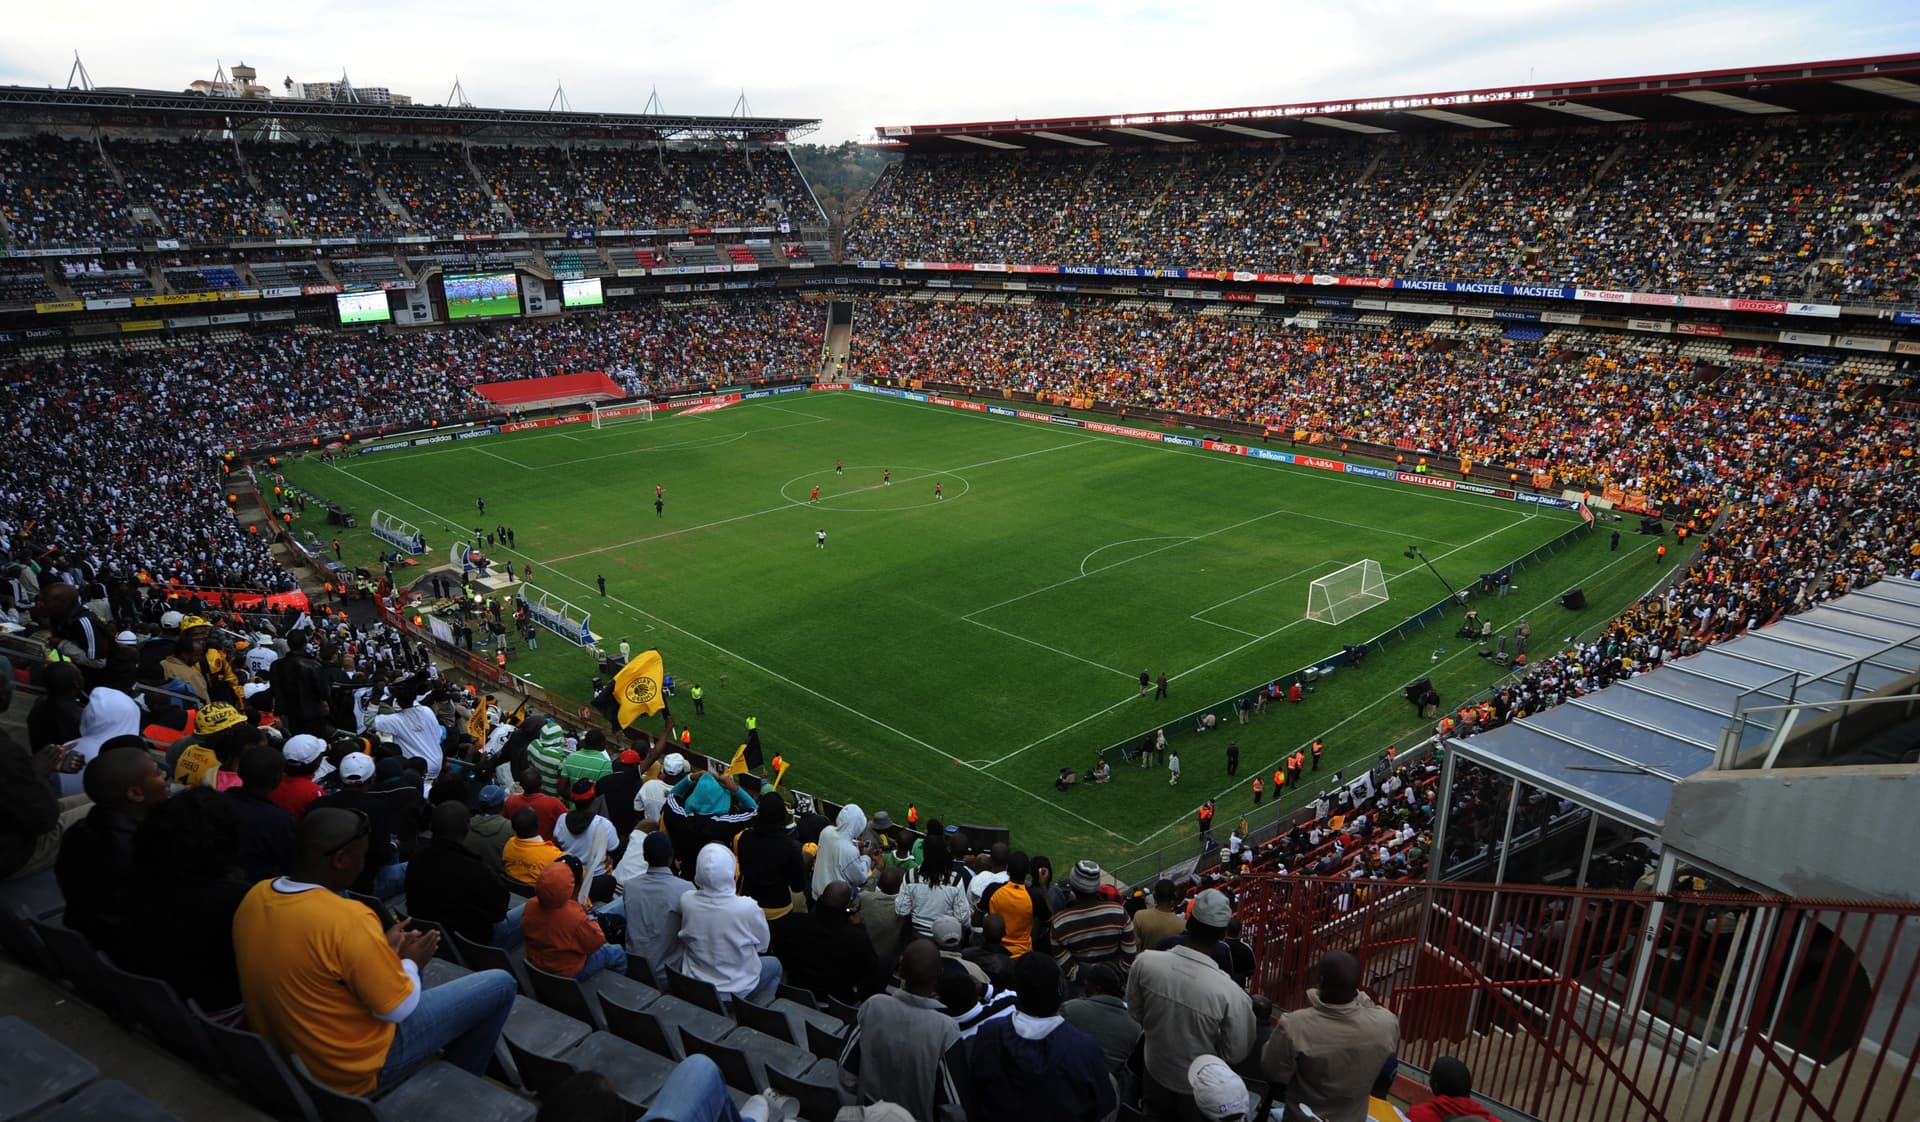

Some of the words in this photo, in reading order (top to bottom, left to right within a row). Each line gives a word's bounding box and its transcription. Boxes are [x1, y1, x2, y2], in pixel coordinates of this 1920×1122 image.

[1871, 213, 1883, 221] 70
[1065, 267, 1098, 275] MACSTEEL
[1104, 268, 1138, 276] MACSTEEL
[1402, 281, 1448, 291] MACSTEEL
[1456, 284, 1504, 294] MACSTEEL
[1513, 287, 1564, 298] MACSTEEL
[1599, 291, 1624, 299] Citizen
[1494, 311, 1525, 319] MACSTEEL
[745, 391, 769, 399] vodacom
[989, 407, 1015, 416] vodacom
[1018, 411, 1035, 419] CASTLE
[459, 428, 491, 439] vodacom
[429, 435, 452, 443] adidas
[1163, 434, 1193, 446] vodacom
[372, 441, 408, 452] GREYHOUND
[1259, 450, 1286, 462] Telkom
[1315, 459, 1334, 469] ABSA
[1352, 466, 1374, 475] Standard
[1400, 473, 1427, 485] CASTLE
[1428, 477, 1451, 489] LAGER
[1517, 492, 1538, 502] Super
[1538, 495, 1556, 505] Diski
